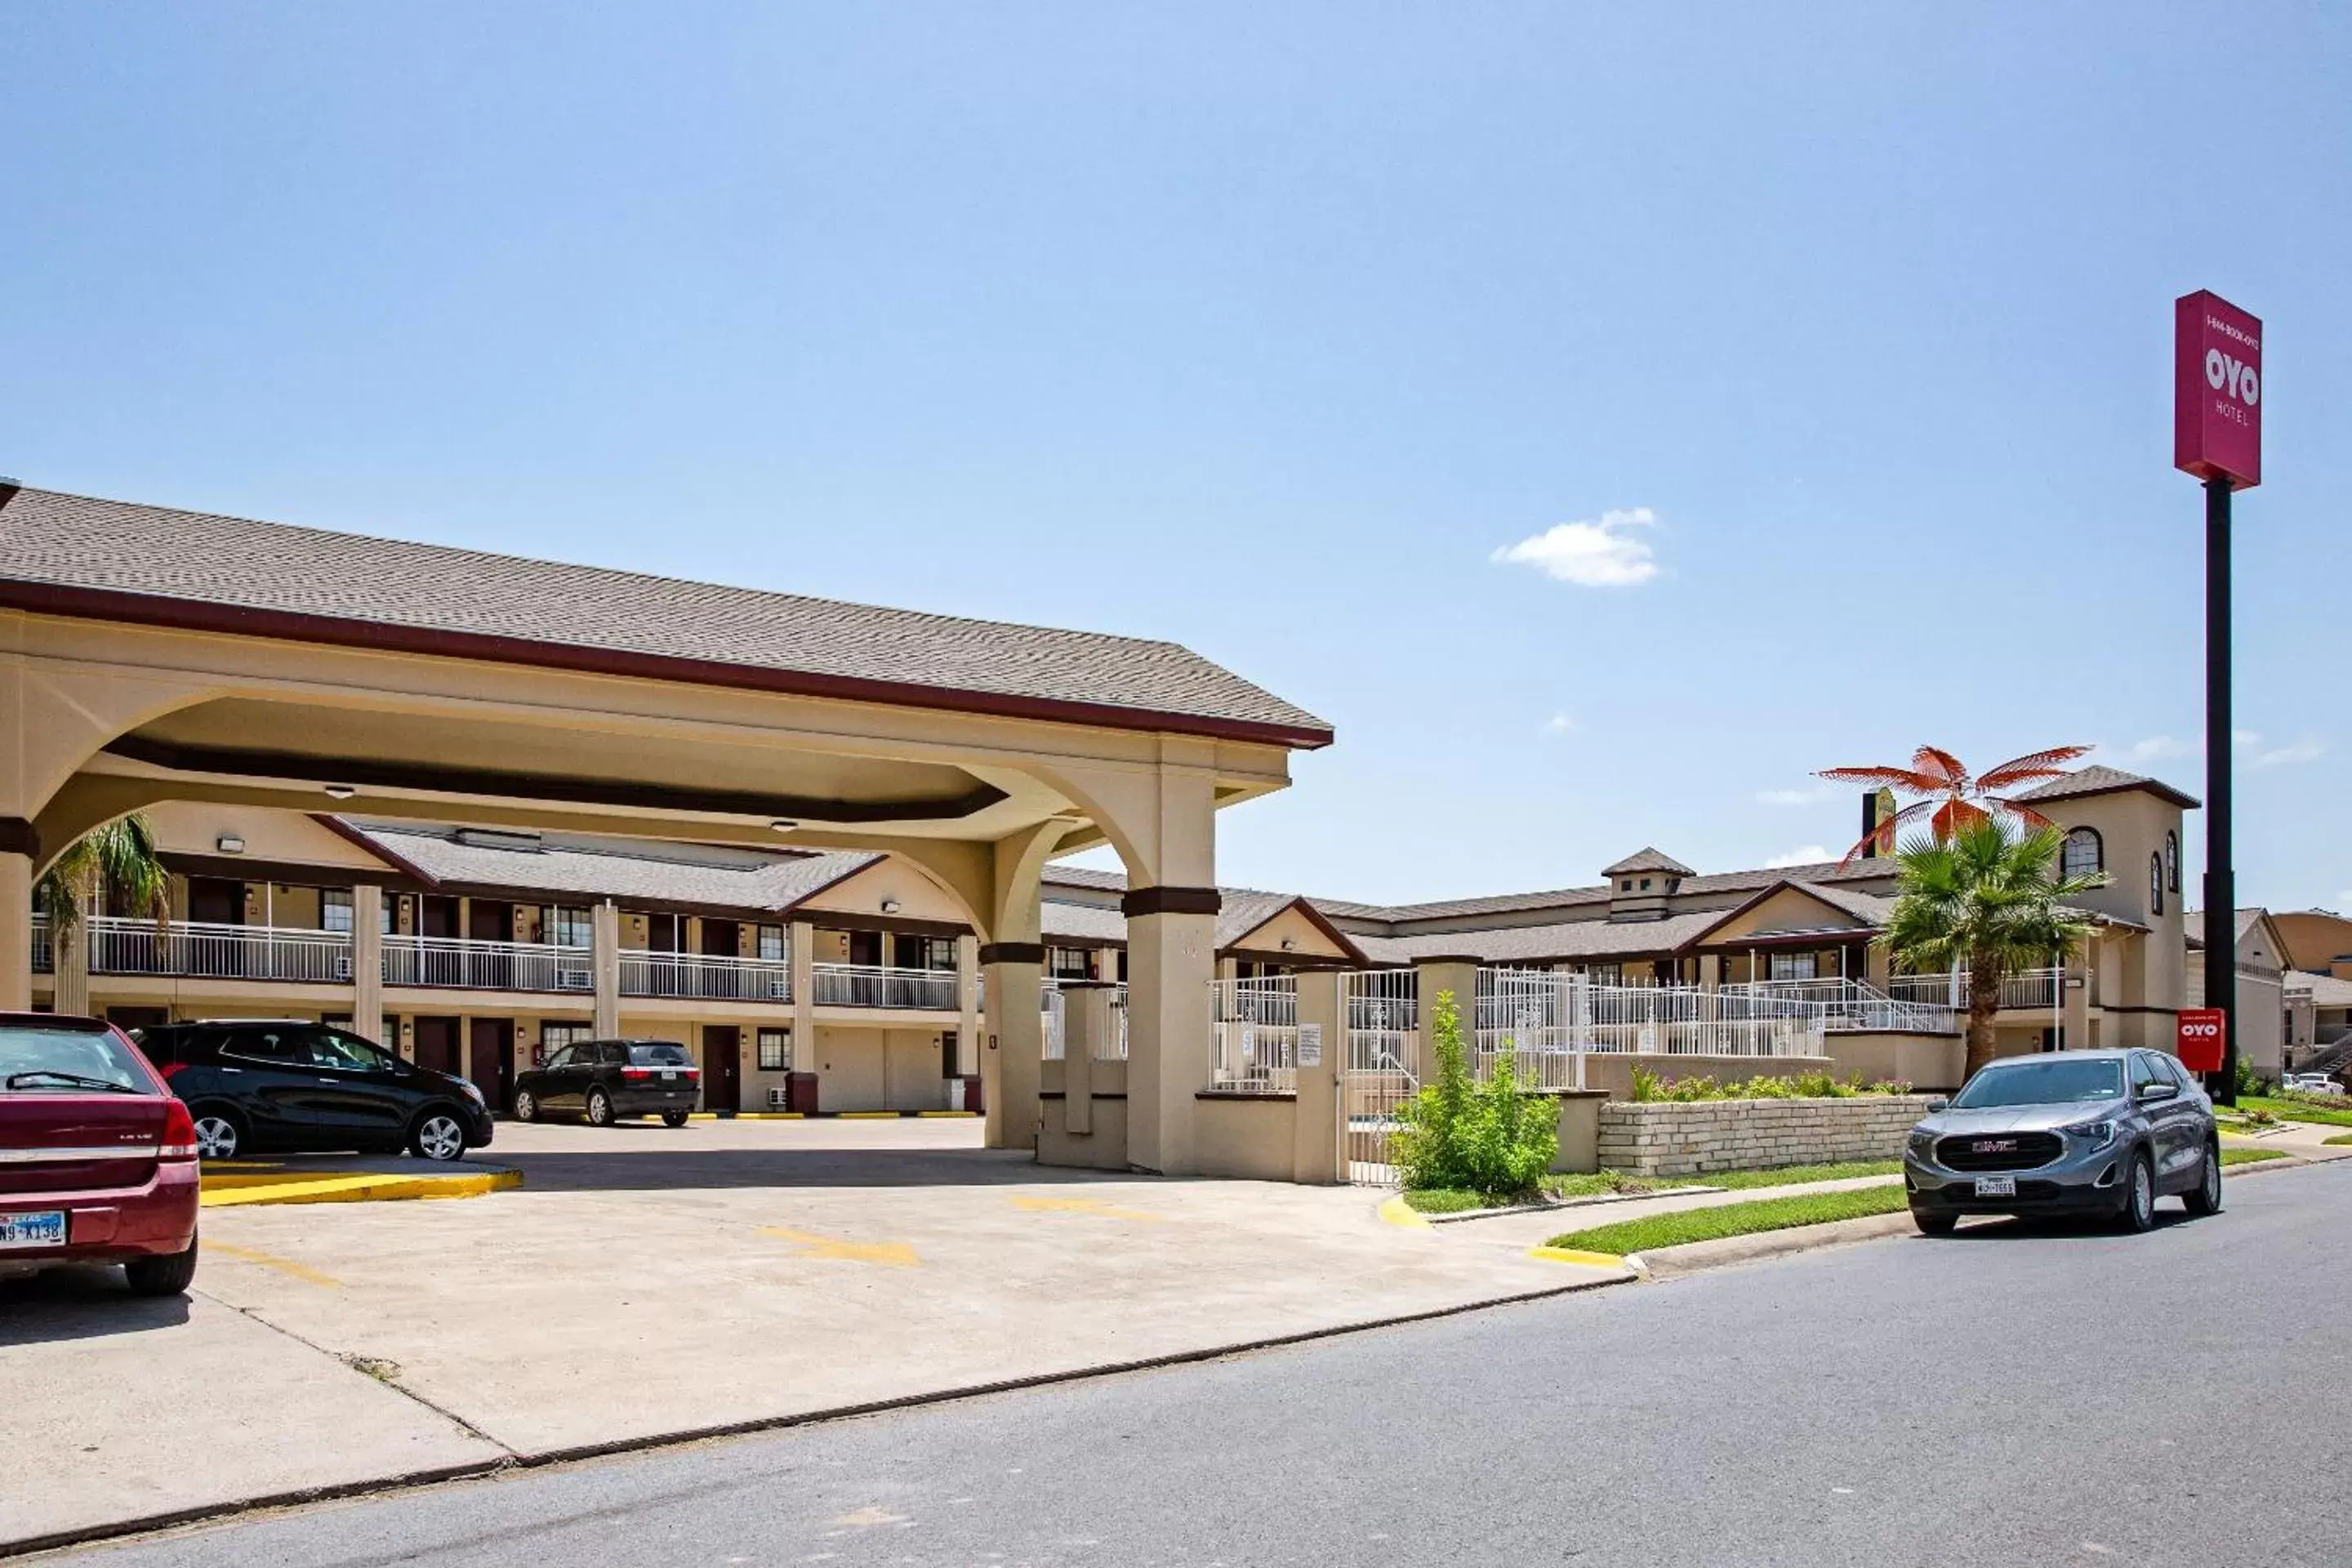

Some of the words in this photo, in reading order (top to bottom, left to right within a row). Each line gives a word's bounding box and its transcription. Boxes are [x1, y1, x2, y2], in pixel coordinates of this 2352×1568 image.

[2206, 349, 2259, 405] OYO
[2216, 399, 2248, 426] HOTEL
[2181, 1024, 2217, 1036] OYO
[1972, 1139, 2017, 1152] GMC
